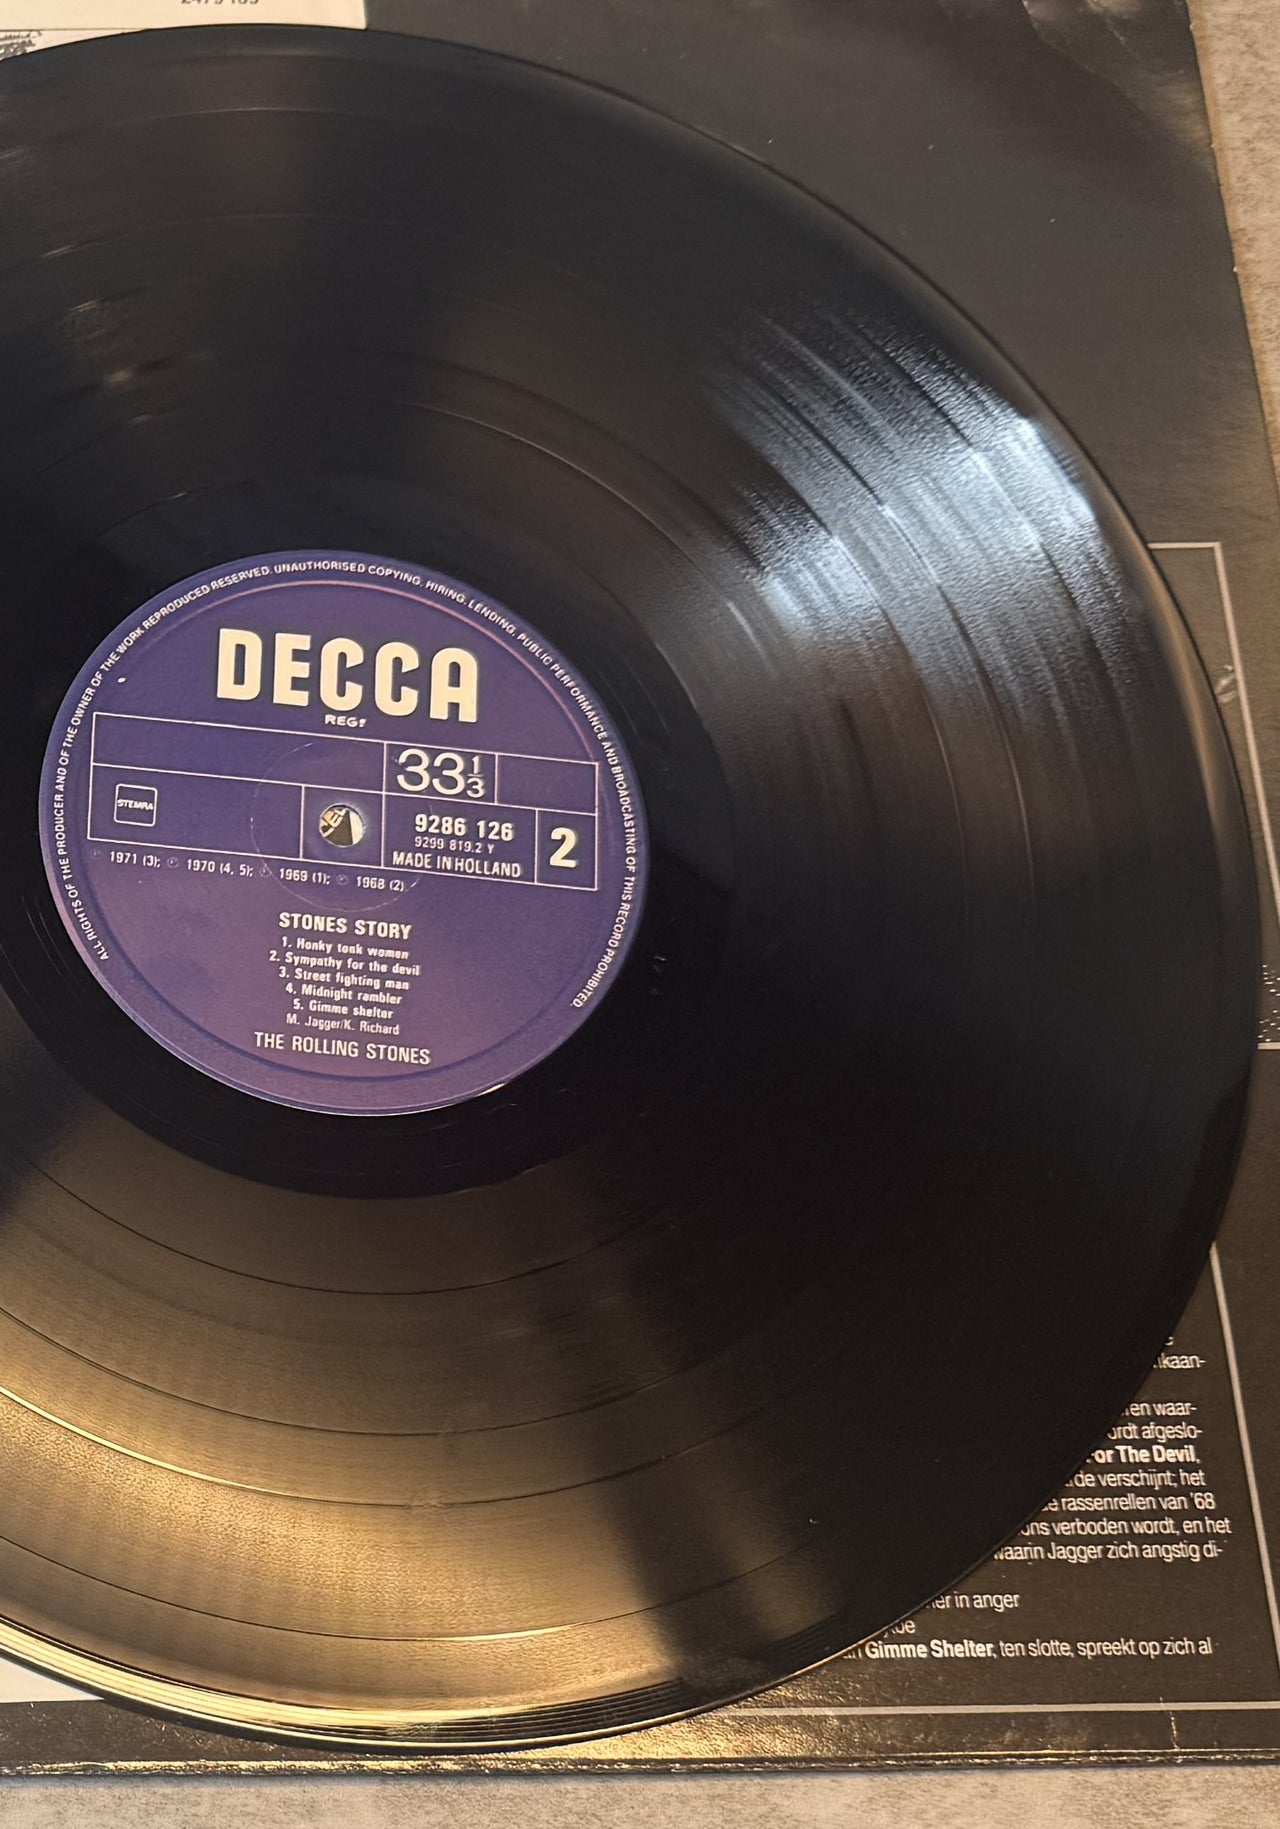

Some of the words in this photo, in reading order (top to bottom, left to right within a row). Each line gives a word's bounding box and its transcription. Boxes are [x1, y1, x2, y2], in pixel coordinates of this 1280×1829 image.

[216, 627, 479, 724] DECCA
[116, 798, 154, 812] STEMRA
[415, 814, 466, 836] 9286
[477, 820, 514, 841] 126
[415, 836, 444, 850] 9299
[550, 827, 577, 868] 2
[109, 851, 138, 865] 1971
[186, 859, 216, 873] 1970
[279, 867, 308, 882] 1969
[356, 875, 385, 889] 1968
[392, 851, 432, 869] MADE
[437, 855, 452, 870] IN
[455, 857, 521, 878] HOLLAND
[279, 912, 348, 934] STONES
[354, 919, 412, 940] STORY
[296, 938, 333, 953] Honky
[367, 948, 410, 960] women
[285, 952, 342, 970] Sympathy
[392, 963, 420, 976] devil
[294, 968, 331, 983] Street
[335, 971, 381, 990] fighting
[385, 980, 410, 991] man
[301, 984, 353, 1001] Midnight
[357, 991, 402, 1005] rambler
[309, 1000, 348, 1015] Gimme
[353, 1006, 394, 1020] shelter
[359, 1020, 400, 1035] Richard
[254, 1031, 285, 1050] THE
[292, 1035, 359, 1058] ROLLING
[366, 1043, 432, 1066] STONES
[1154, 1402, 1197, 1417] waar-
[1141, 1423, 1203, 1443] afgeslo-
[1115, 1446, 1148, 1463] The
[1180, 1470, 1206, 1486] het
[1061, 1493, 1156, 1510] rassenrellen
[1160, 1496, 1188, 1509] van
[1053, 1518, 1127, 1535] verboden
[1131, 1517, 1179, 1536] wordt,
[1206, 1517, 1232, 1533] het
[1047, 1542, 1103, 1563] Jagger
[1106, 1541, 1137, 1559] zich
[1142, 1542, 1200, 1562] angstig
[973, 1593, 1019, 1612] anger
[865, 1641, 928, 1659] Gimme
[999, 1641, 1026, 1657] ten
[1077, 1638, 1136, 1660] spreekt
[1162, 1638, 1195, 1655] zich
